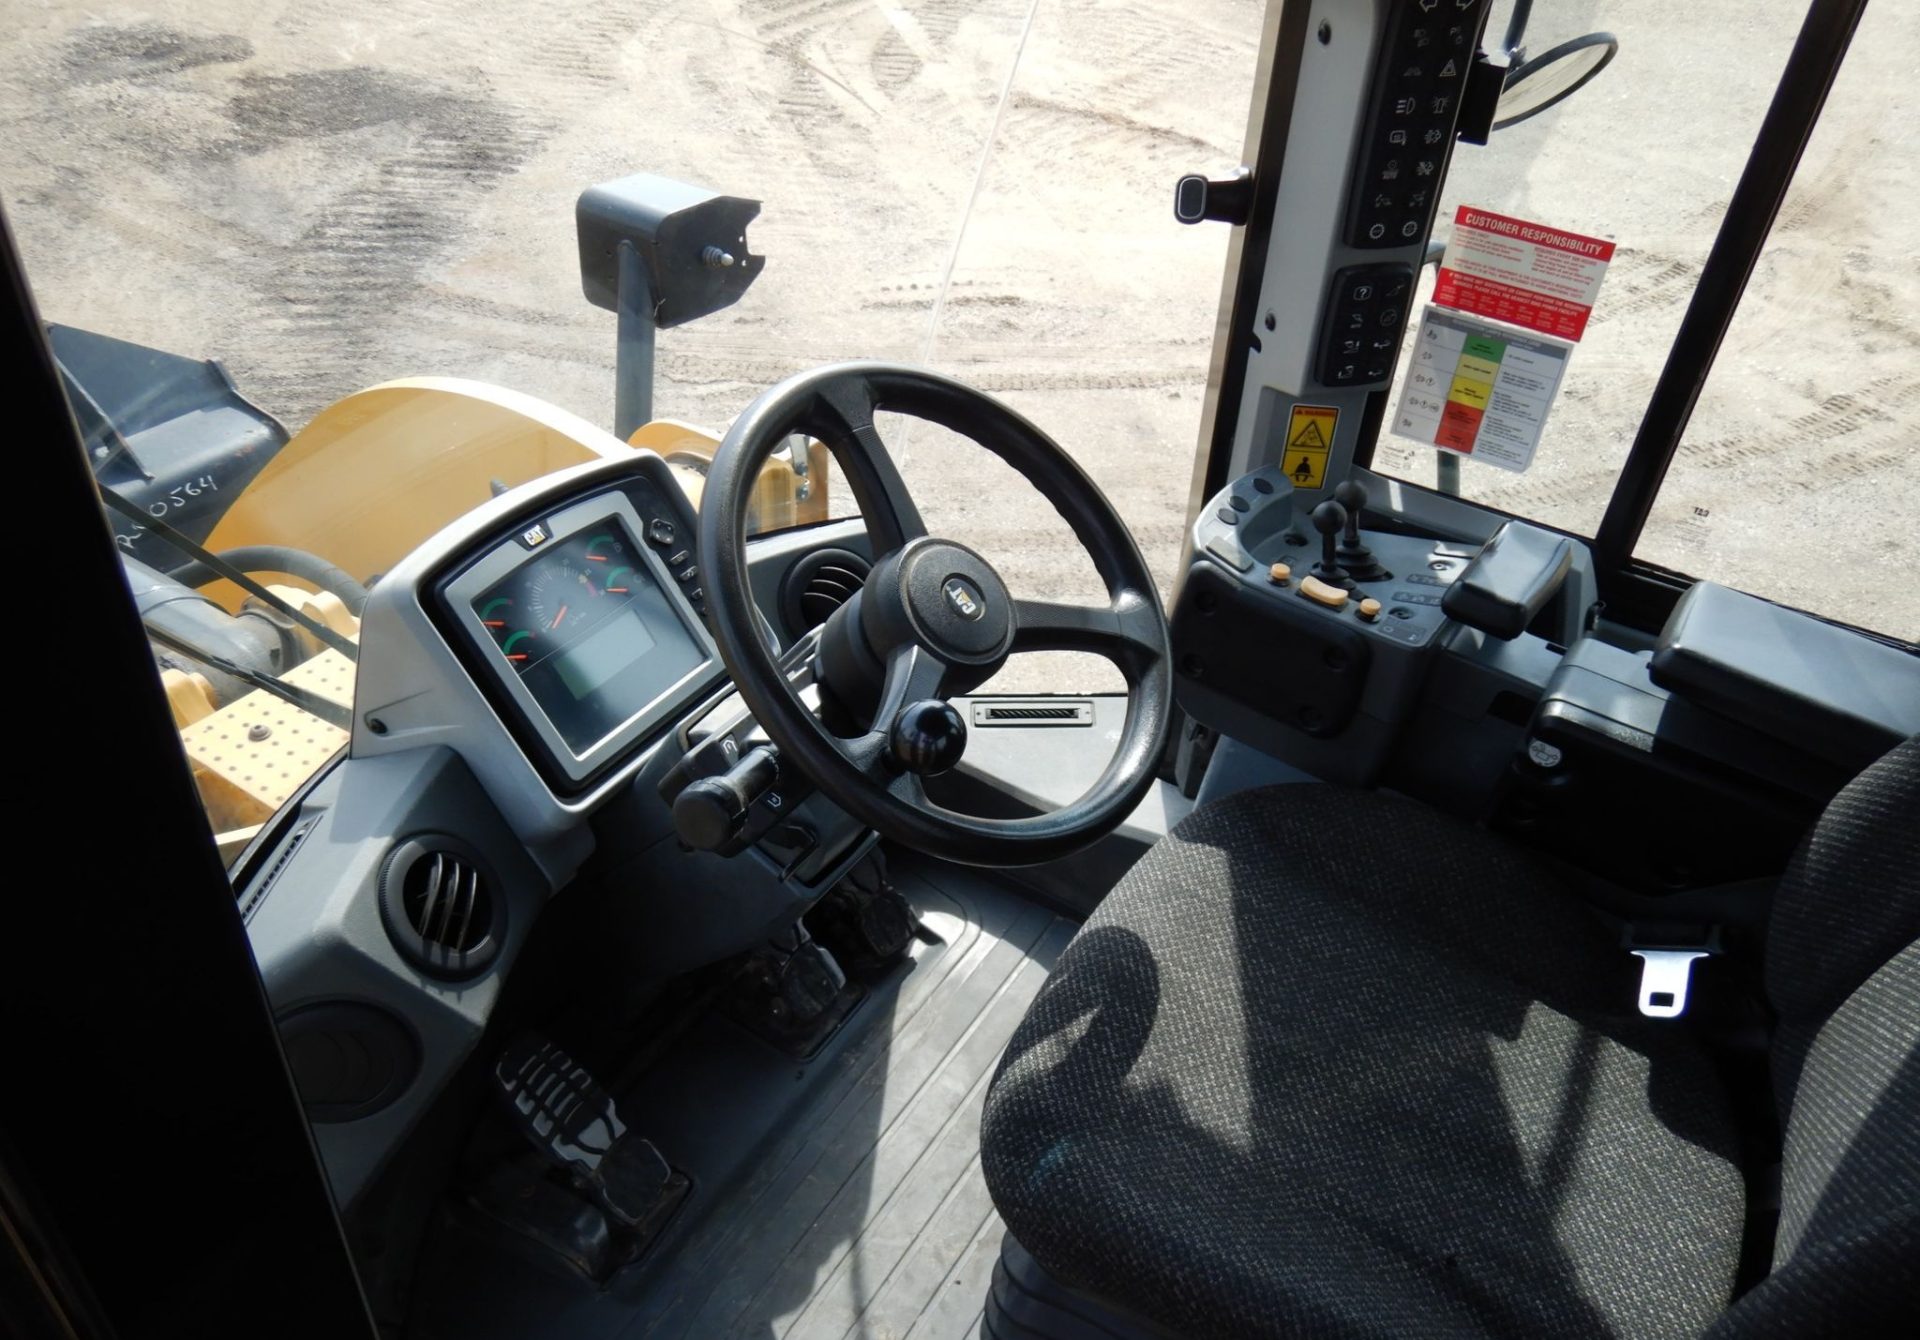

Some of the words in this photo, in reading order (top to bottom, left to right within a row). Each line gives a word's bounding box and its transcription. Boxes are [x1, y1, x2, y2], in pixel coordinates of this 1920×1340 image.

[1465, 213, 1519, 235] CUSTOMER
[1520, 226, 1603, 255] RESPONSIBILITY
[523, 524, 546, 546] CAT
[949, 587, 976, 614] CAT
